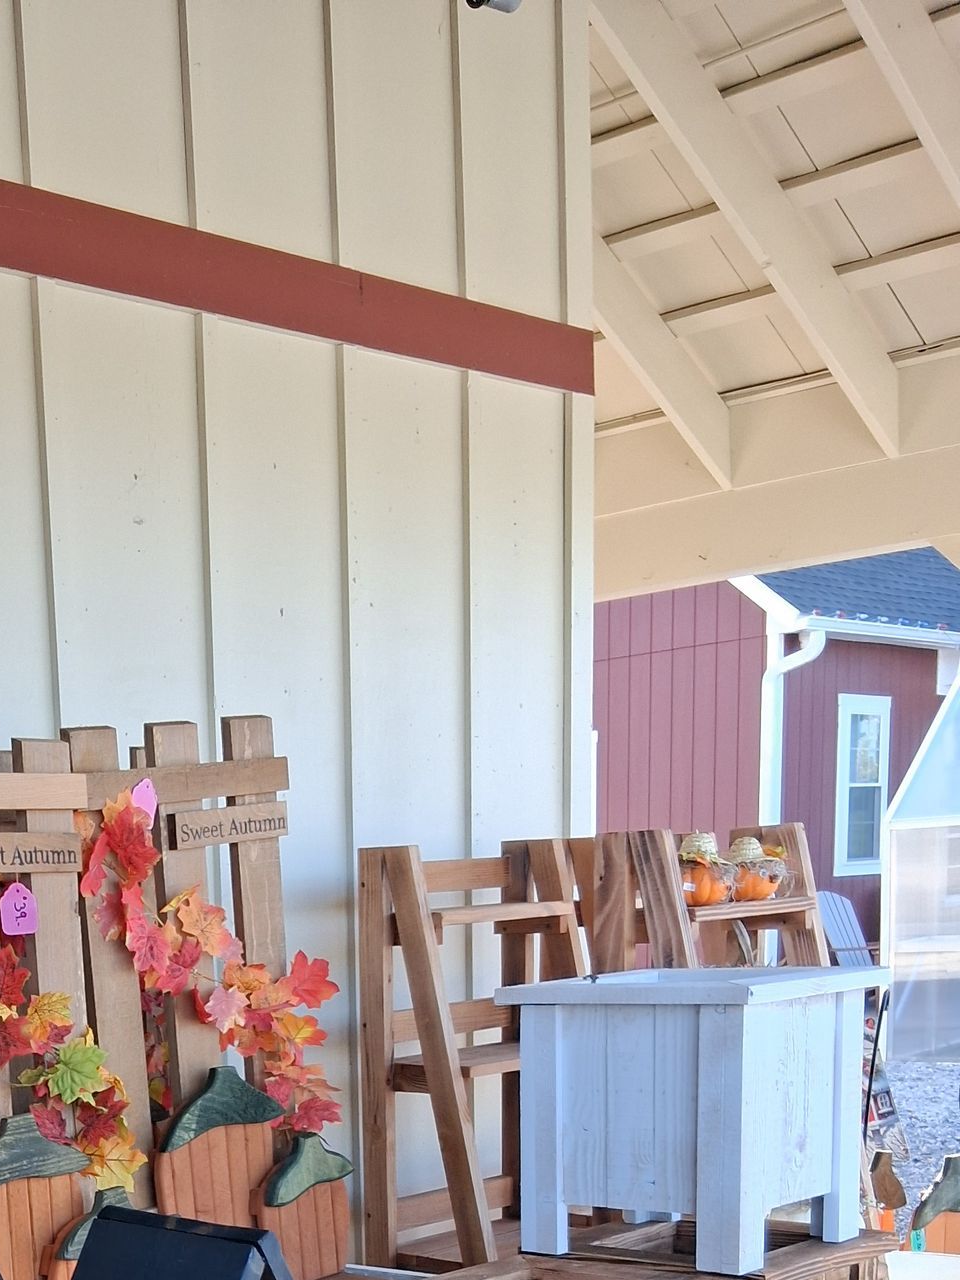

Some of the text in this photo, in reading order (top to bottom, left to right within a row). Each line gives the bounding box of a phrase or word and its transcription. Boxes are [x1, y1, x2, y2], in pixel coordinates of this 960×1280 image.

[180, 815, 286, 843] Sweet Autumn
[11, 845, 78, 866] Autumn
